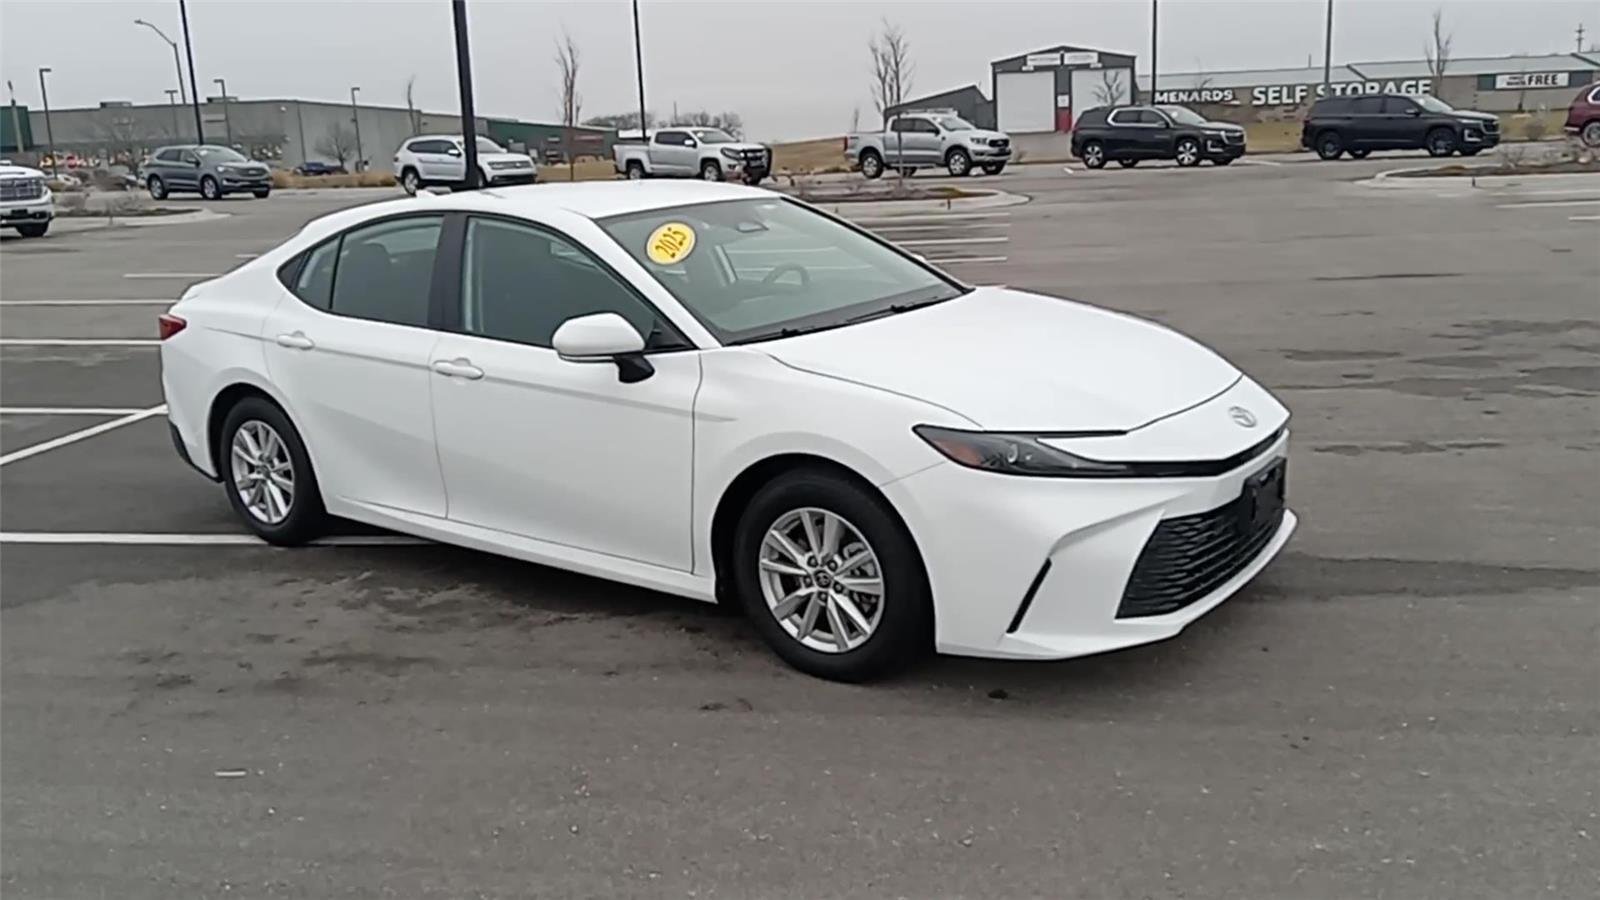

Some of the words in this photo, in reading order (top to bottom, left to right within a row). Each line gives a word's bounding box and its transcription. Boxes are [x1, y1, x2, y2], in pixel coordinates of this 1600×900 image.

[1528, 74, 1558, 85] FREE
[1154, 89, 1233, 103] MENARDS
[1252, 86, 1307, 105] SELF
[1315, 80, 1432, 100] STORAGE
[655, 227, 687, 259] 2025
